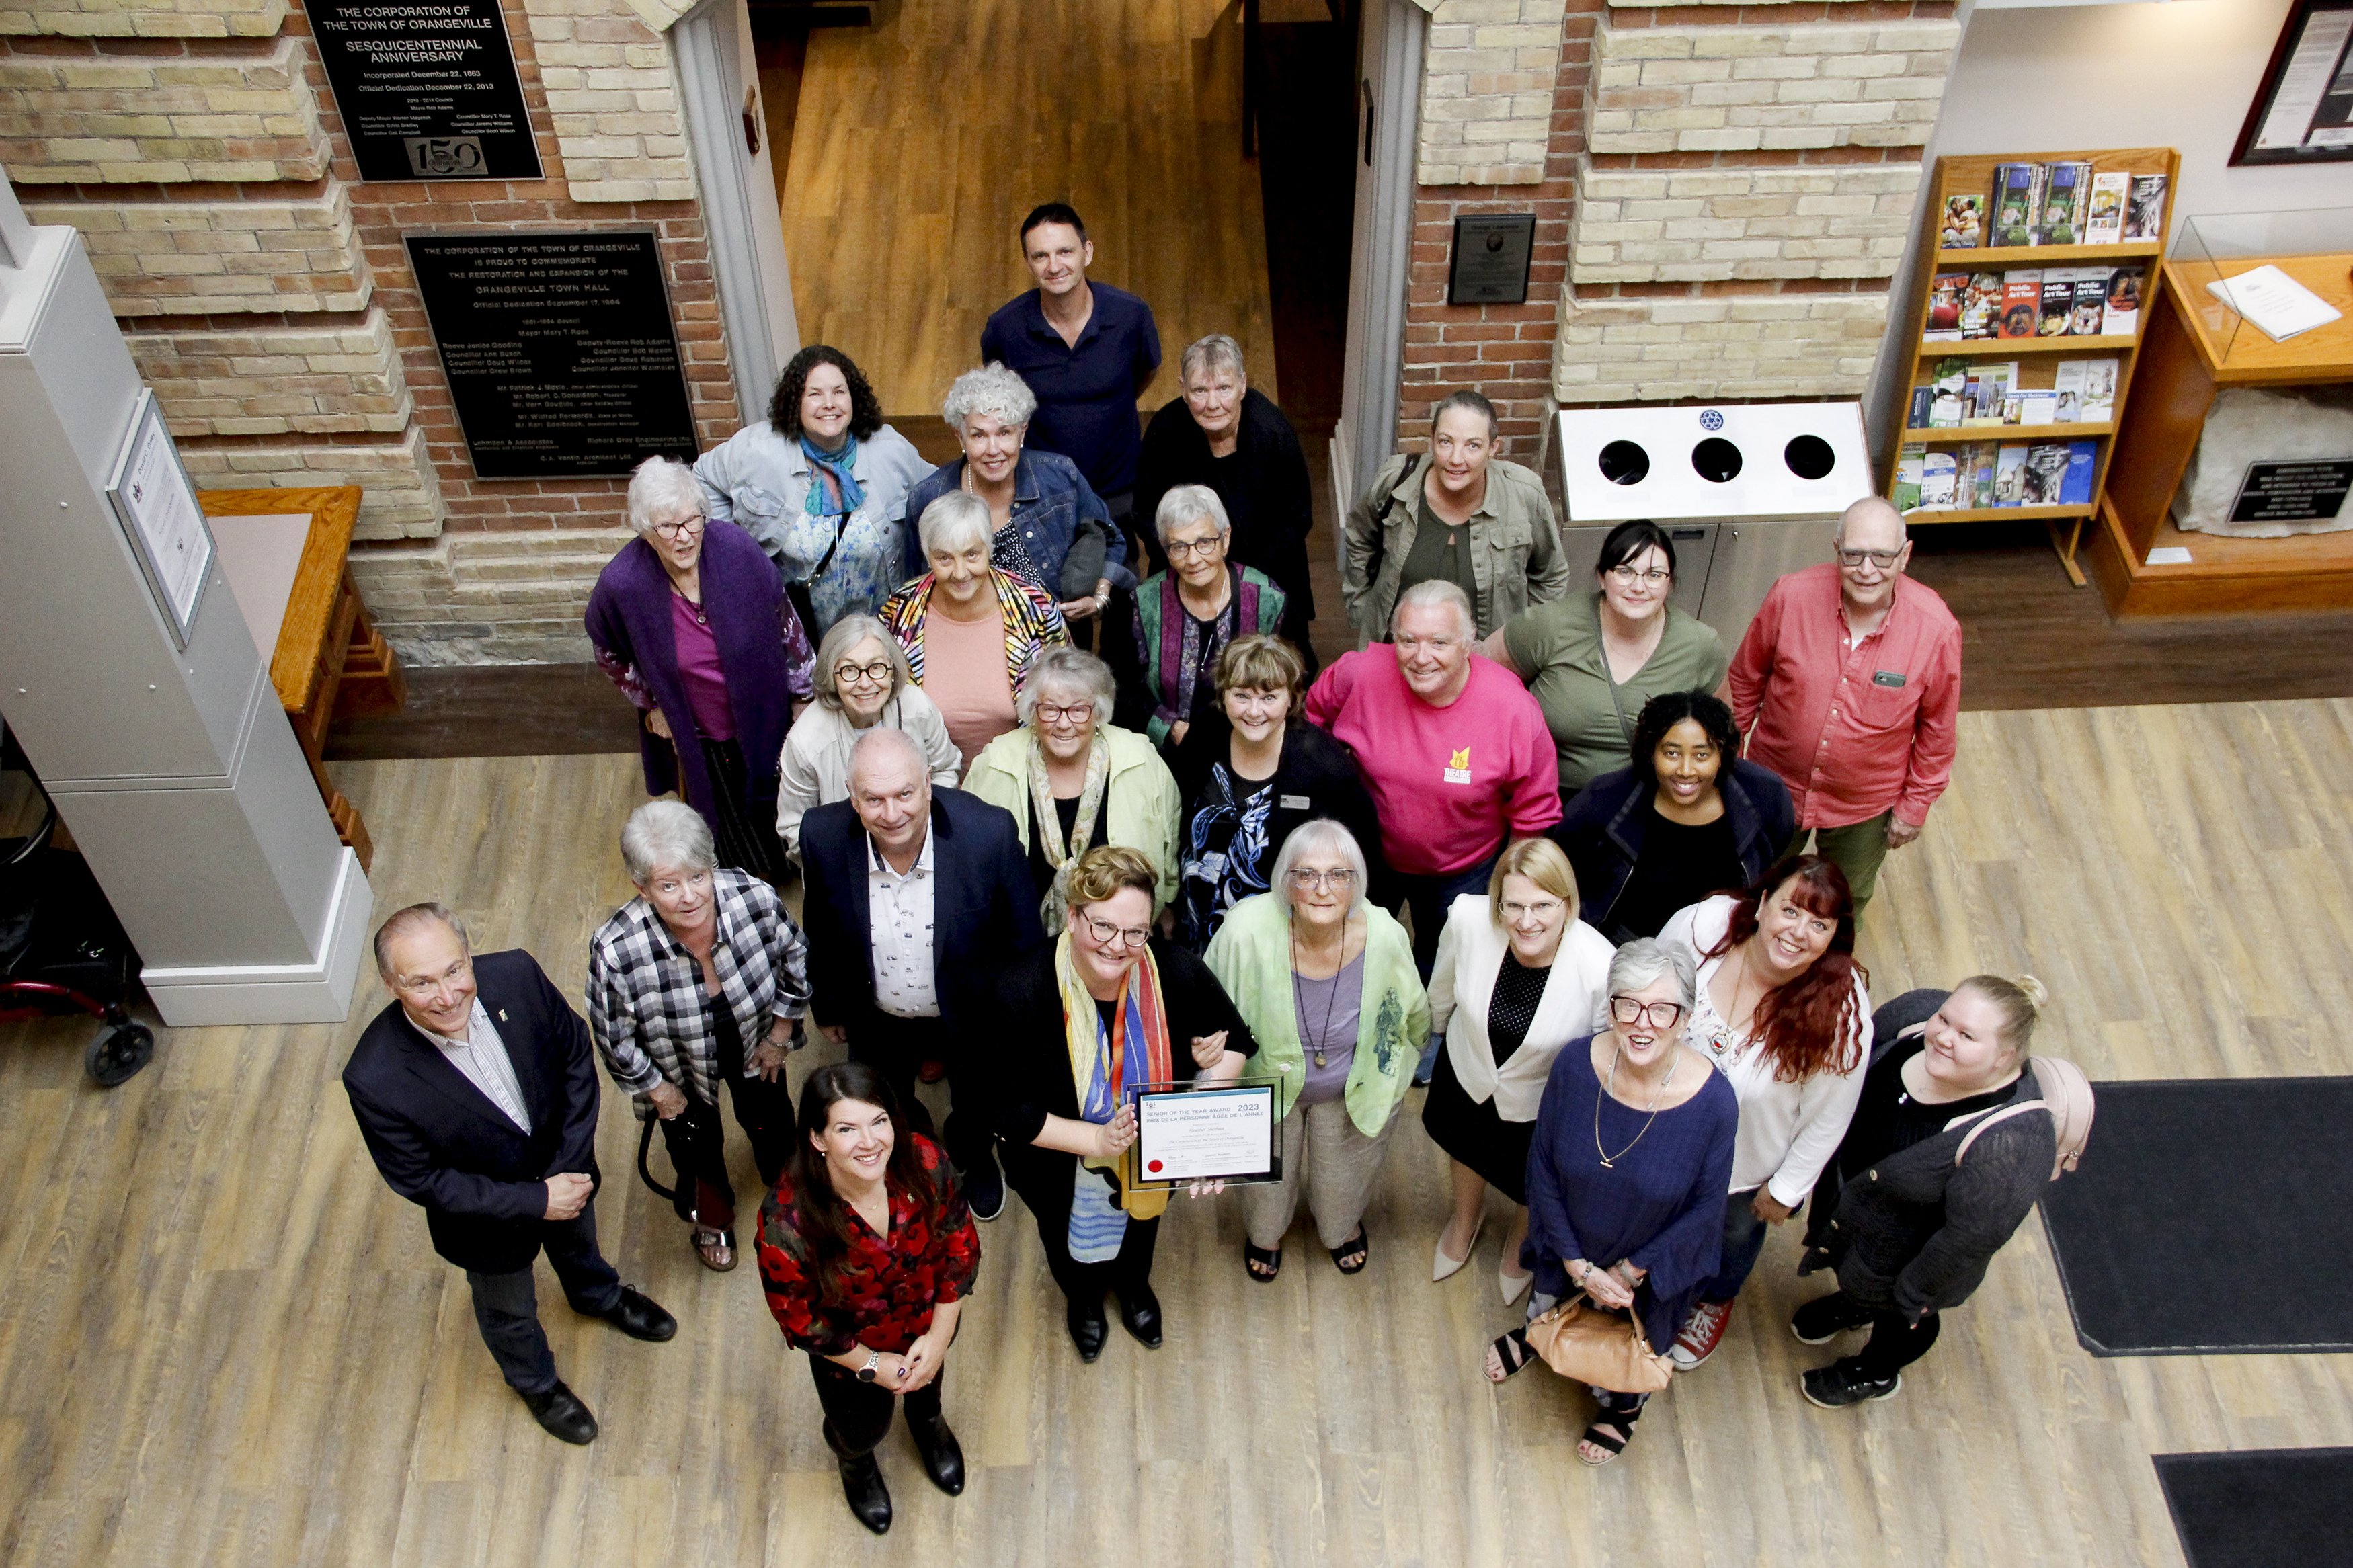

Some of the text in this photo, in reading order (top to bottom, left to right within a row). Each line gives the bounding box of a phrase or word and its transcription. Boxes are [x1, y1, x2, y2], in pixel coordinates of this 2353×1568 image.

[335, 6, 471, 17] THE CORPORATION OF
[323, 18, 492, 31] THE TOWN OF ORANGEVILLE
[346, 39, 483, 52] SESQUICENTENNIAL
[371, 52, 464, 63] ANNIVERSARY
[411, 71, 448, 79] December
[358, 84, 384, 92] Official
[424, 83, 462, 91] December
[463, 83, 475, 91] 22,
[424, 247, 442, 255] THE
[444, 247, 504, 255] CORPORATION
[583, 244, 641, 252] ORANGEVILLE
[531, 257, 596, 265] COMMEMORATE
[469, 271, 525, 279] RESTORATION
[475, 286, 545, 294] ORANGEVILLE
[549, 284, 579, 293] TOWN
[503, 300, 545, 308] Dedication
[547, 300, 588, 308] September
[1444, 768, 1472, 778] THEATRE
